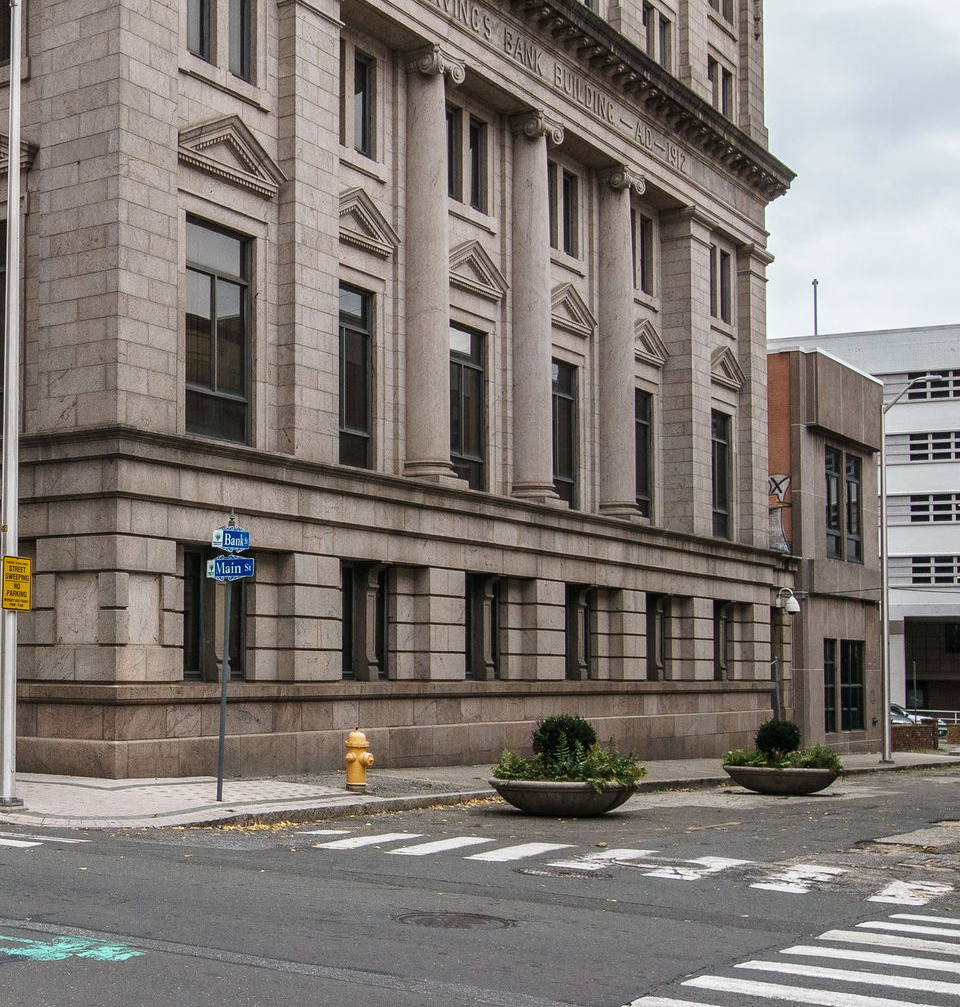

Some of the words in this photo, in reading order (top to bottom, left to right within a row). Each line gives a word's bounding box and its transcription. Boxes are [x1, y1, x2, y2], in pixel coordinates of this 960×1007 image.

[503, 27, 543, 77] BANK
[553, 62, 614, 125] BUILDING
[224, 533, 244, 546] Bank
[9, 565, 27, 574] STREET
[216, 562, 242, 574] Main
[5, 573, 30, 581] SWEEPING
[6, 590, 28, 598] PARKING
